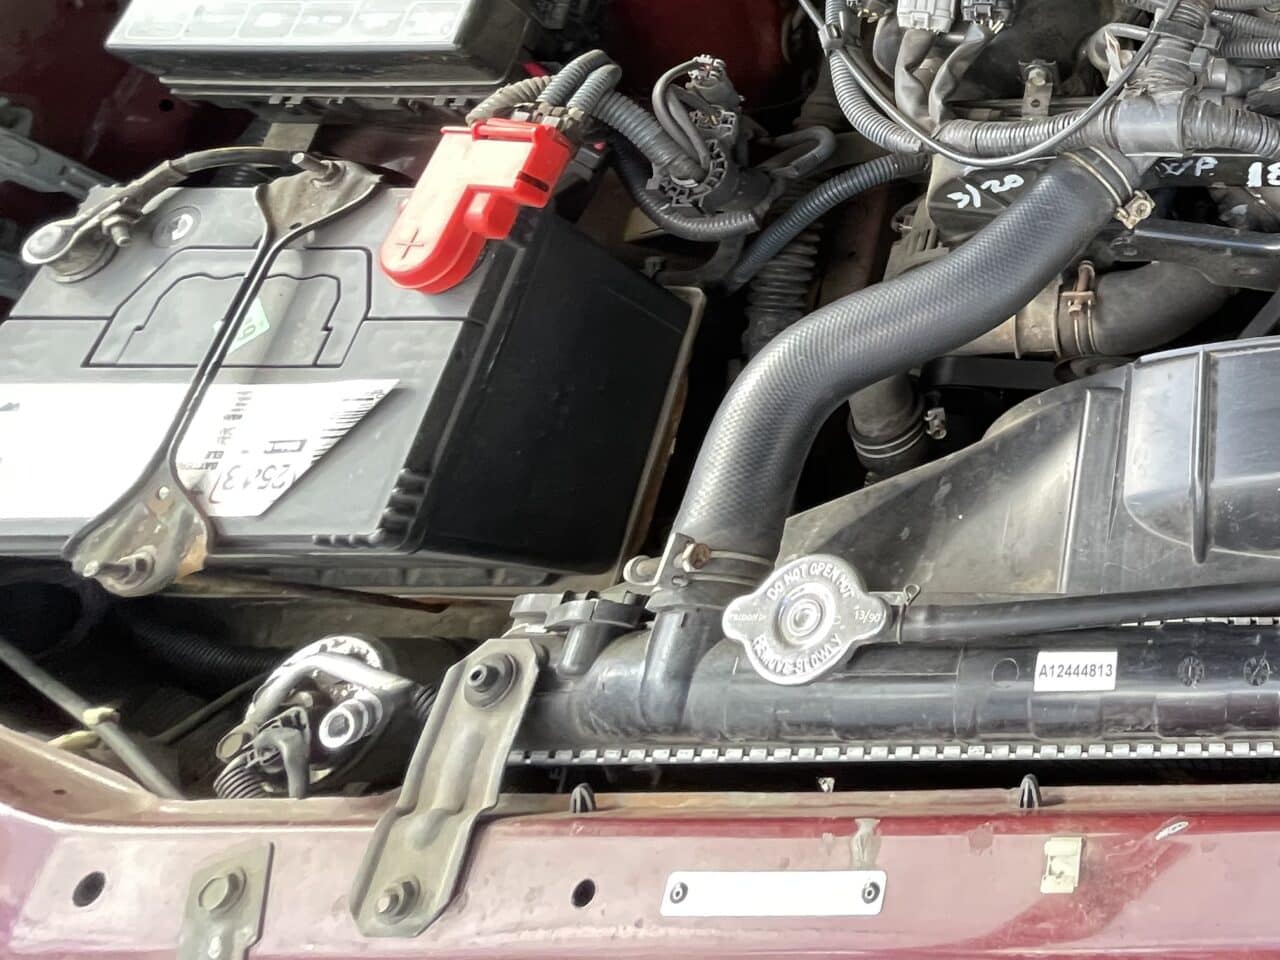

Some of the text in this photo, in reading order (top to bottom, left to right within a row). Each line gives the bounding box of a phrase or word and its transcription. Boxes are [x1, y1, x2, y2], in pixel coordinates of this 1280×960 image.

[766, 583, 785, 601] DO
[785, 563, 808, 586] NOT
[809, 561, 842, 583] OPEN
[752, 633, 842, 675] REMOVE SLOWLY
[1038, 663, 1114, 679] A12444813
